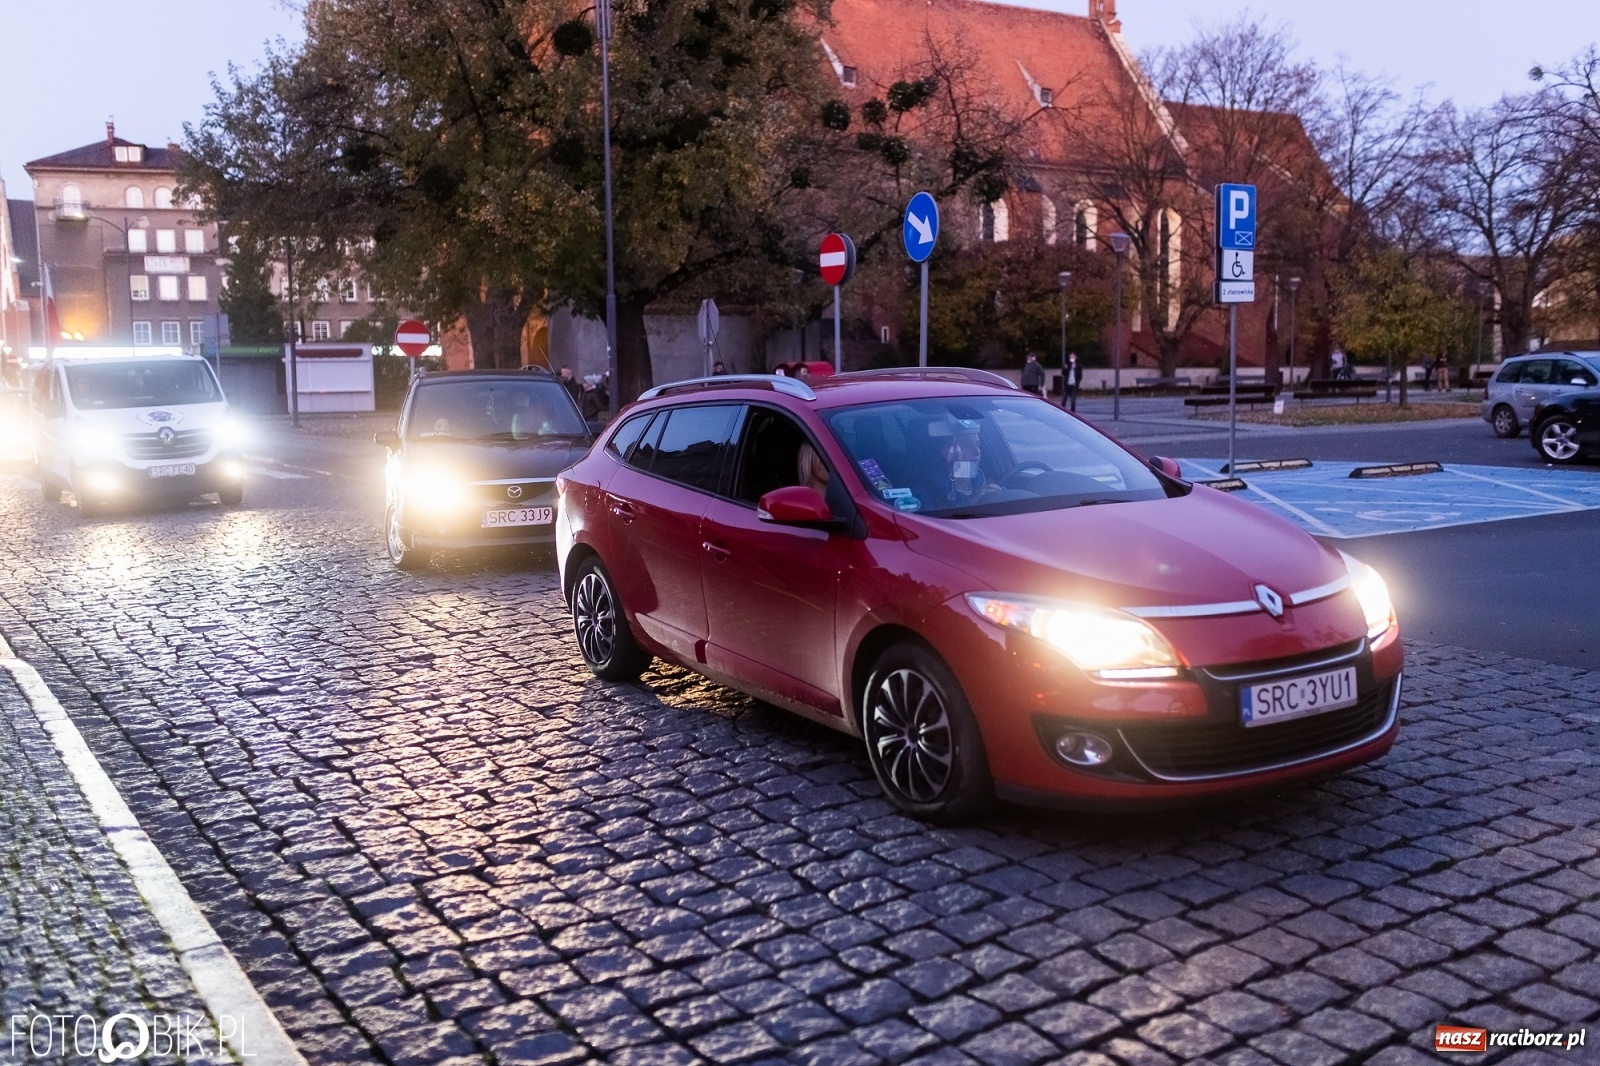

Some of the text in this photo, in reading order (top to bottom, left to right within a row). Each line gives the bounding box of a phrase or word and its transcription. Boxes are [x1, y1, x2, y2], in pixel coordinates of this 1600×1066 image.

[1229, 189, 1250, 230] P
[153, 466, 170, 477] SRC
[489, 508, 551, 524] SRC 33J9
[1257, 671, 1352, 715] SRC 3YU1
